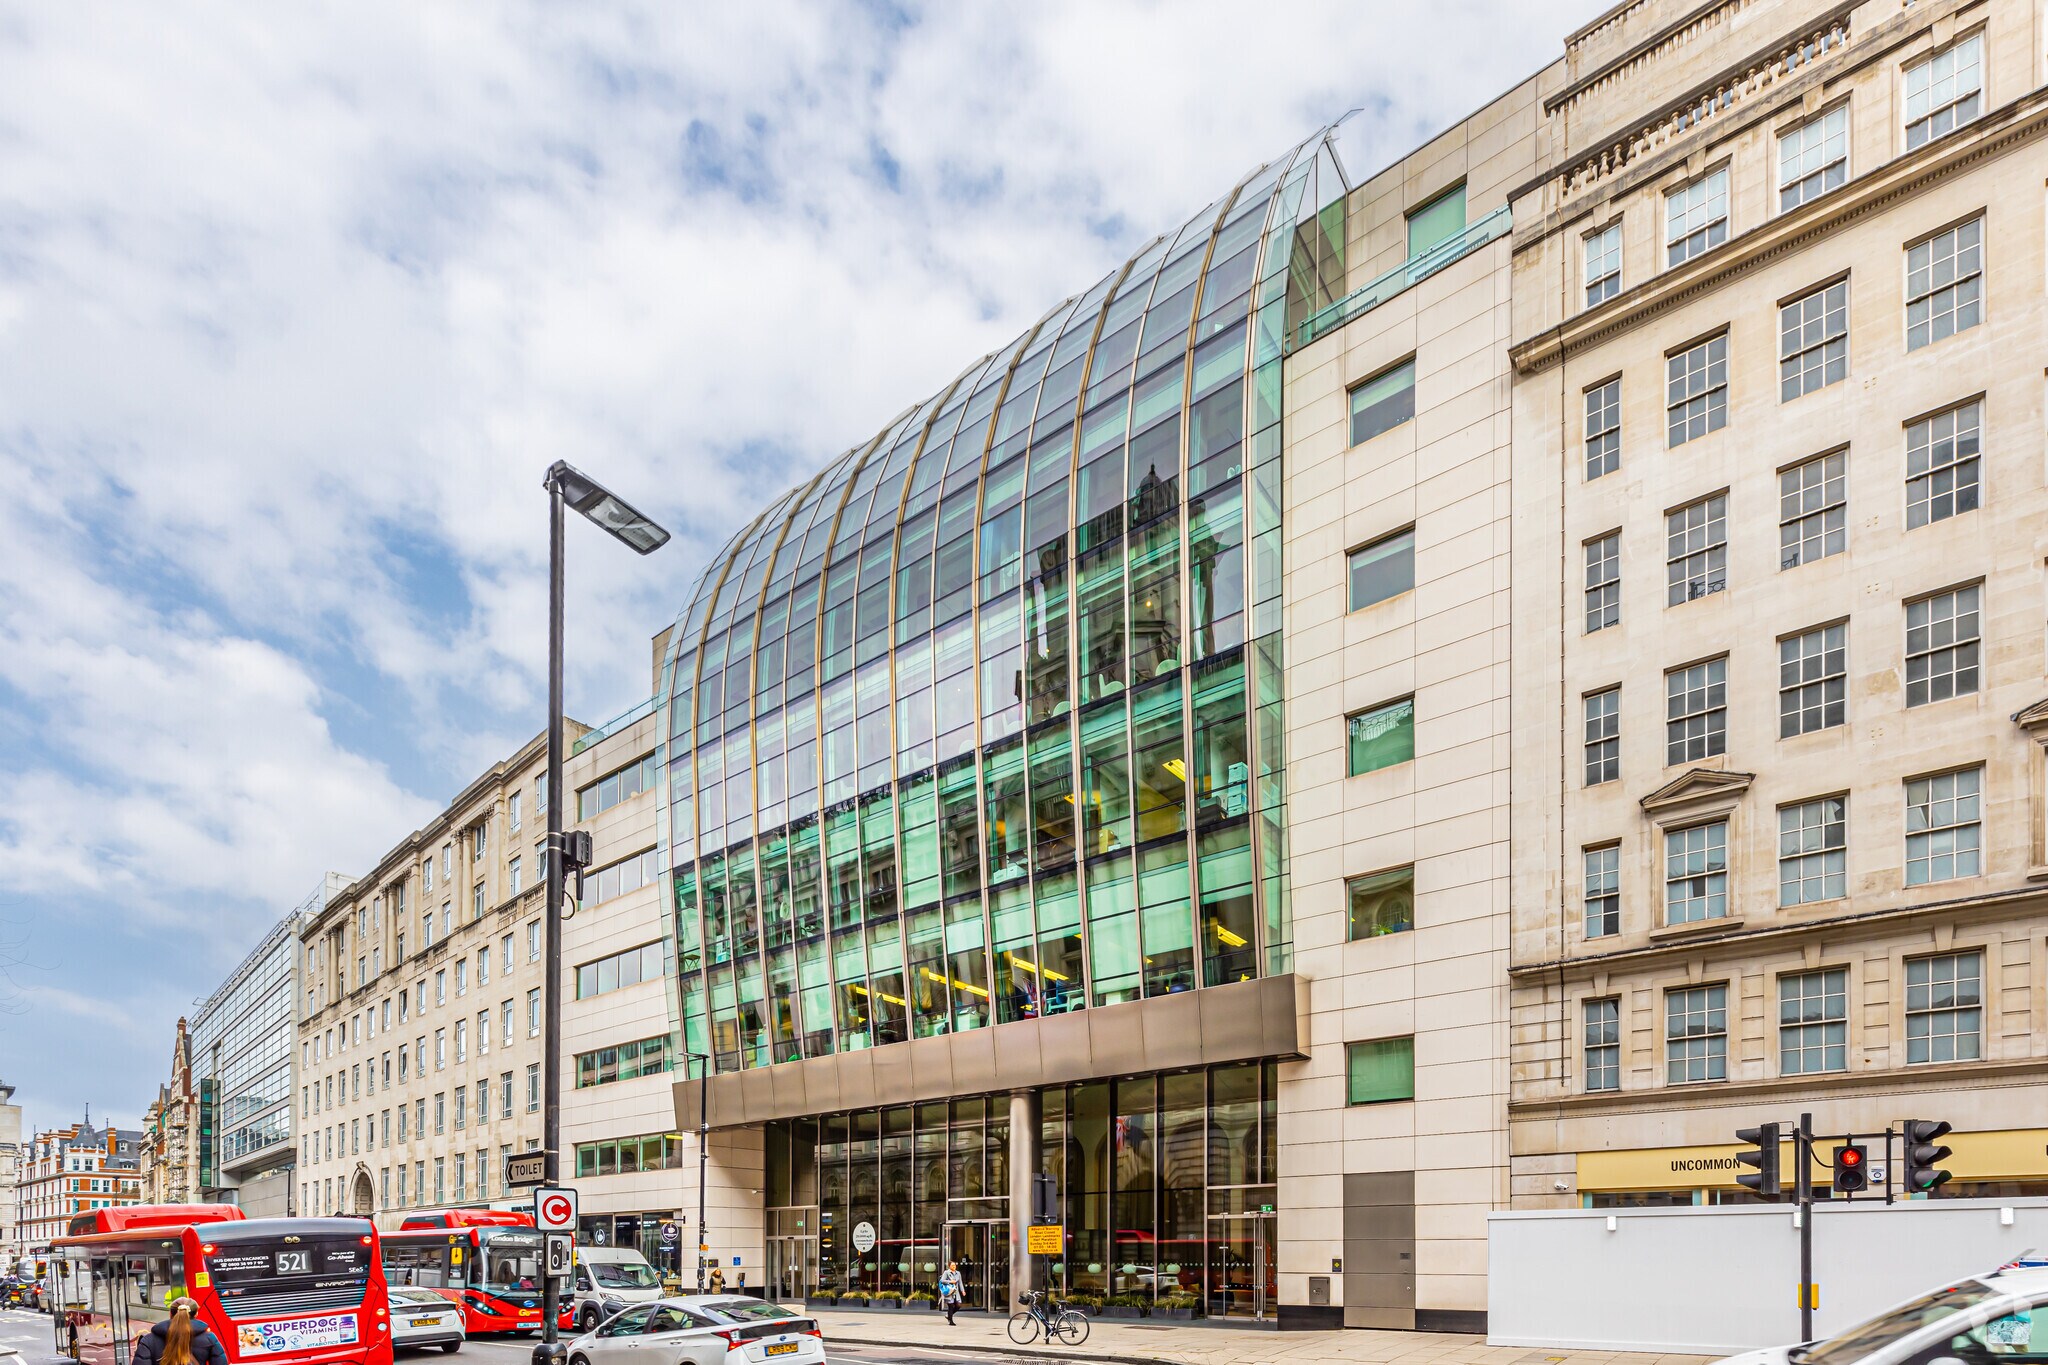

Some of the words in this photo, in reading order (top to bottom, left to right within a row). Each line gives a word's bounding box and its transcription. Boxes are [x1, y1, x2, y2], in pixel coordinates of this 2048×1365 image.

[515, 1162, 543, 1176] TOILET
[1671, 1158, 1741, 1171] UNCOMMON
[544, 1197, 570, 1223] C
[278, 1253, 307, 1272] 521
[263, 1318, 338, 1336] SUPERDOG
[300, 1326, 338, 1335] VITAMINS
